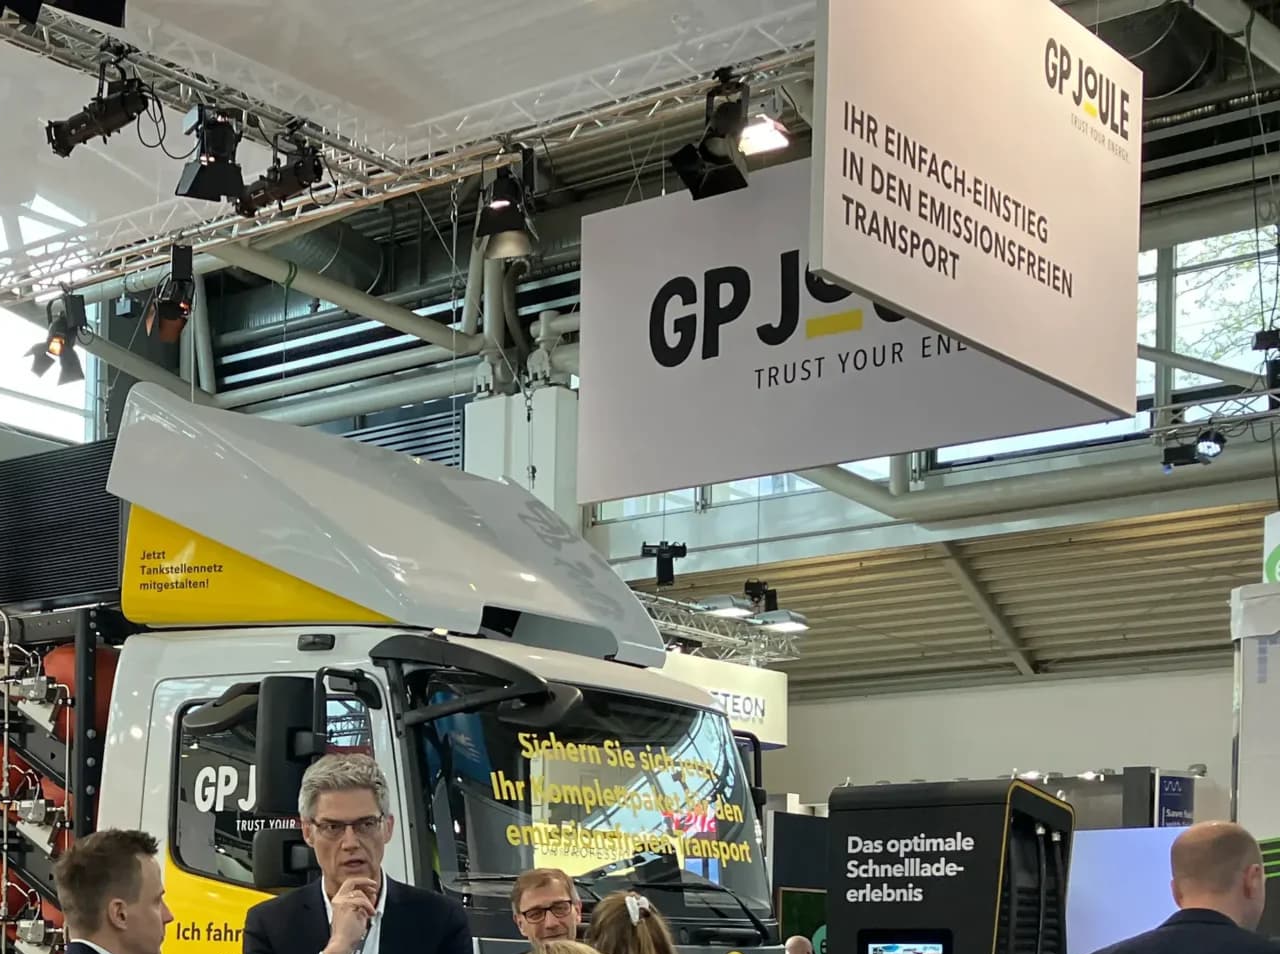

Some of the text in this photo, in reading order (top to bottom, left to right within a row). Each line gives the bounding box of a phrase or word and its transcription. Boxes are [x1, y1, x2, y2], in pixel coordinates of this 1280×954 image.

[1045, 38, 1130, 141] GP JOULE
[843, 100, 1048, 244] IHR EINFACH-EINSTIEG
[841, 193, 960, 280] TRANSPORT
[842, 147, 1073, 299] IN DEN EMISSIONSFREIEN
[649, 266, 751, 368] GP
[754, 357, 825, 390] TRUST
[838, 342, 904, 374] YOUR
[140, 551, 166, 560] Jetzt
[140, 563, 223, 575] Tankstellennetz
[140, 579, 209, 592] mitgestalten!
[710, 691, 765, 717] TEON
[517, 732, 602, 765] Sichern
[603, 739, 636, 768] Sie
[640, 744, 676, 771] sich
[490, 770, 525, 801] Ihr
[716, 793, 744, 824] den
[236, 819, 265, 831] TRUST
[676, 831, 753, 867] Transport
[847, 831, 975, 858] Das optimale
[846, 857, 965, 878] Schnelllade-
[846, 883, 923, 902] erlebnis
[176, 922, 243, 942] Ich fahr
